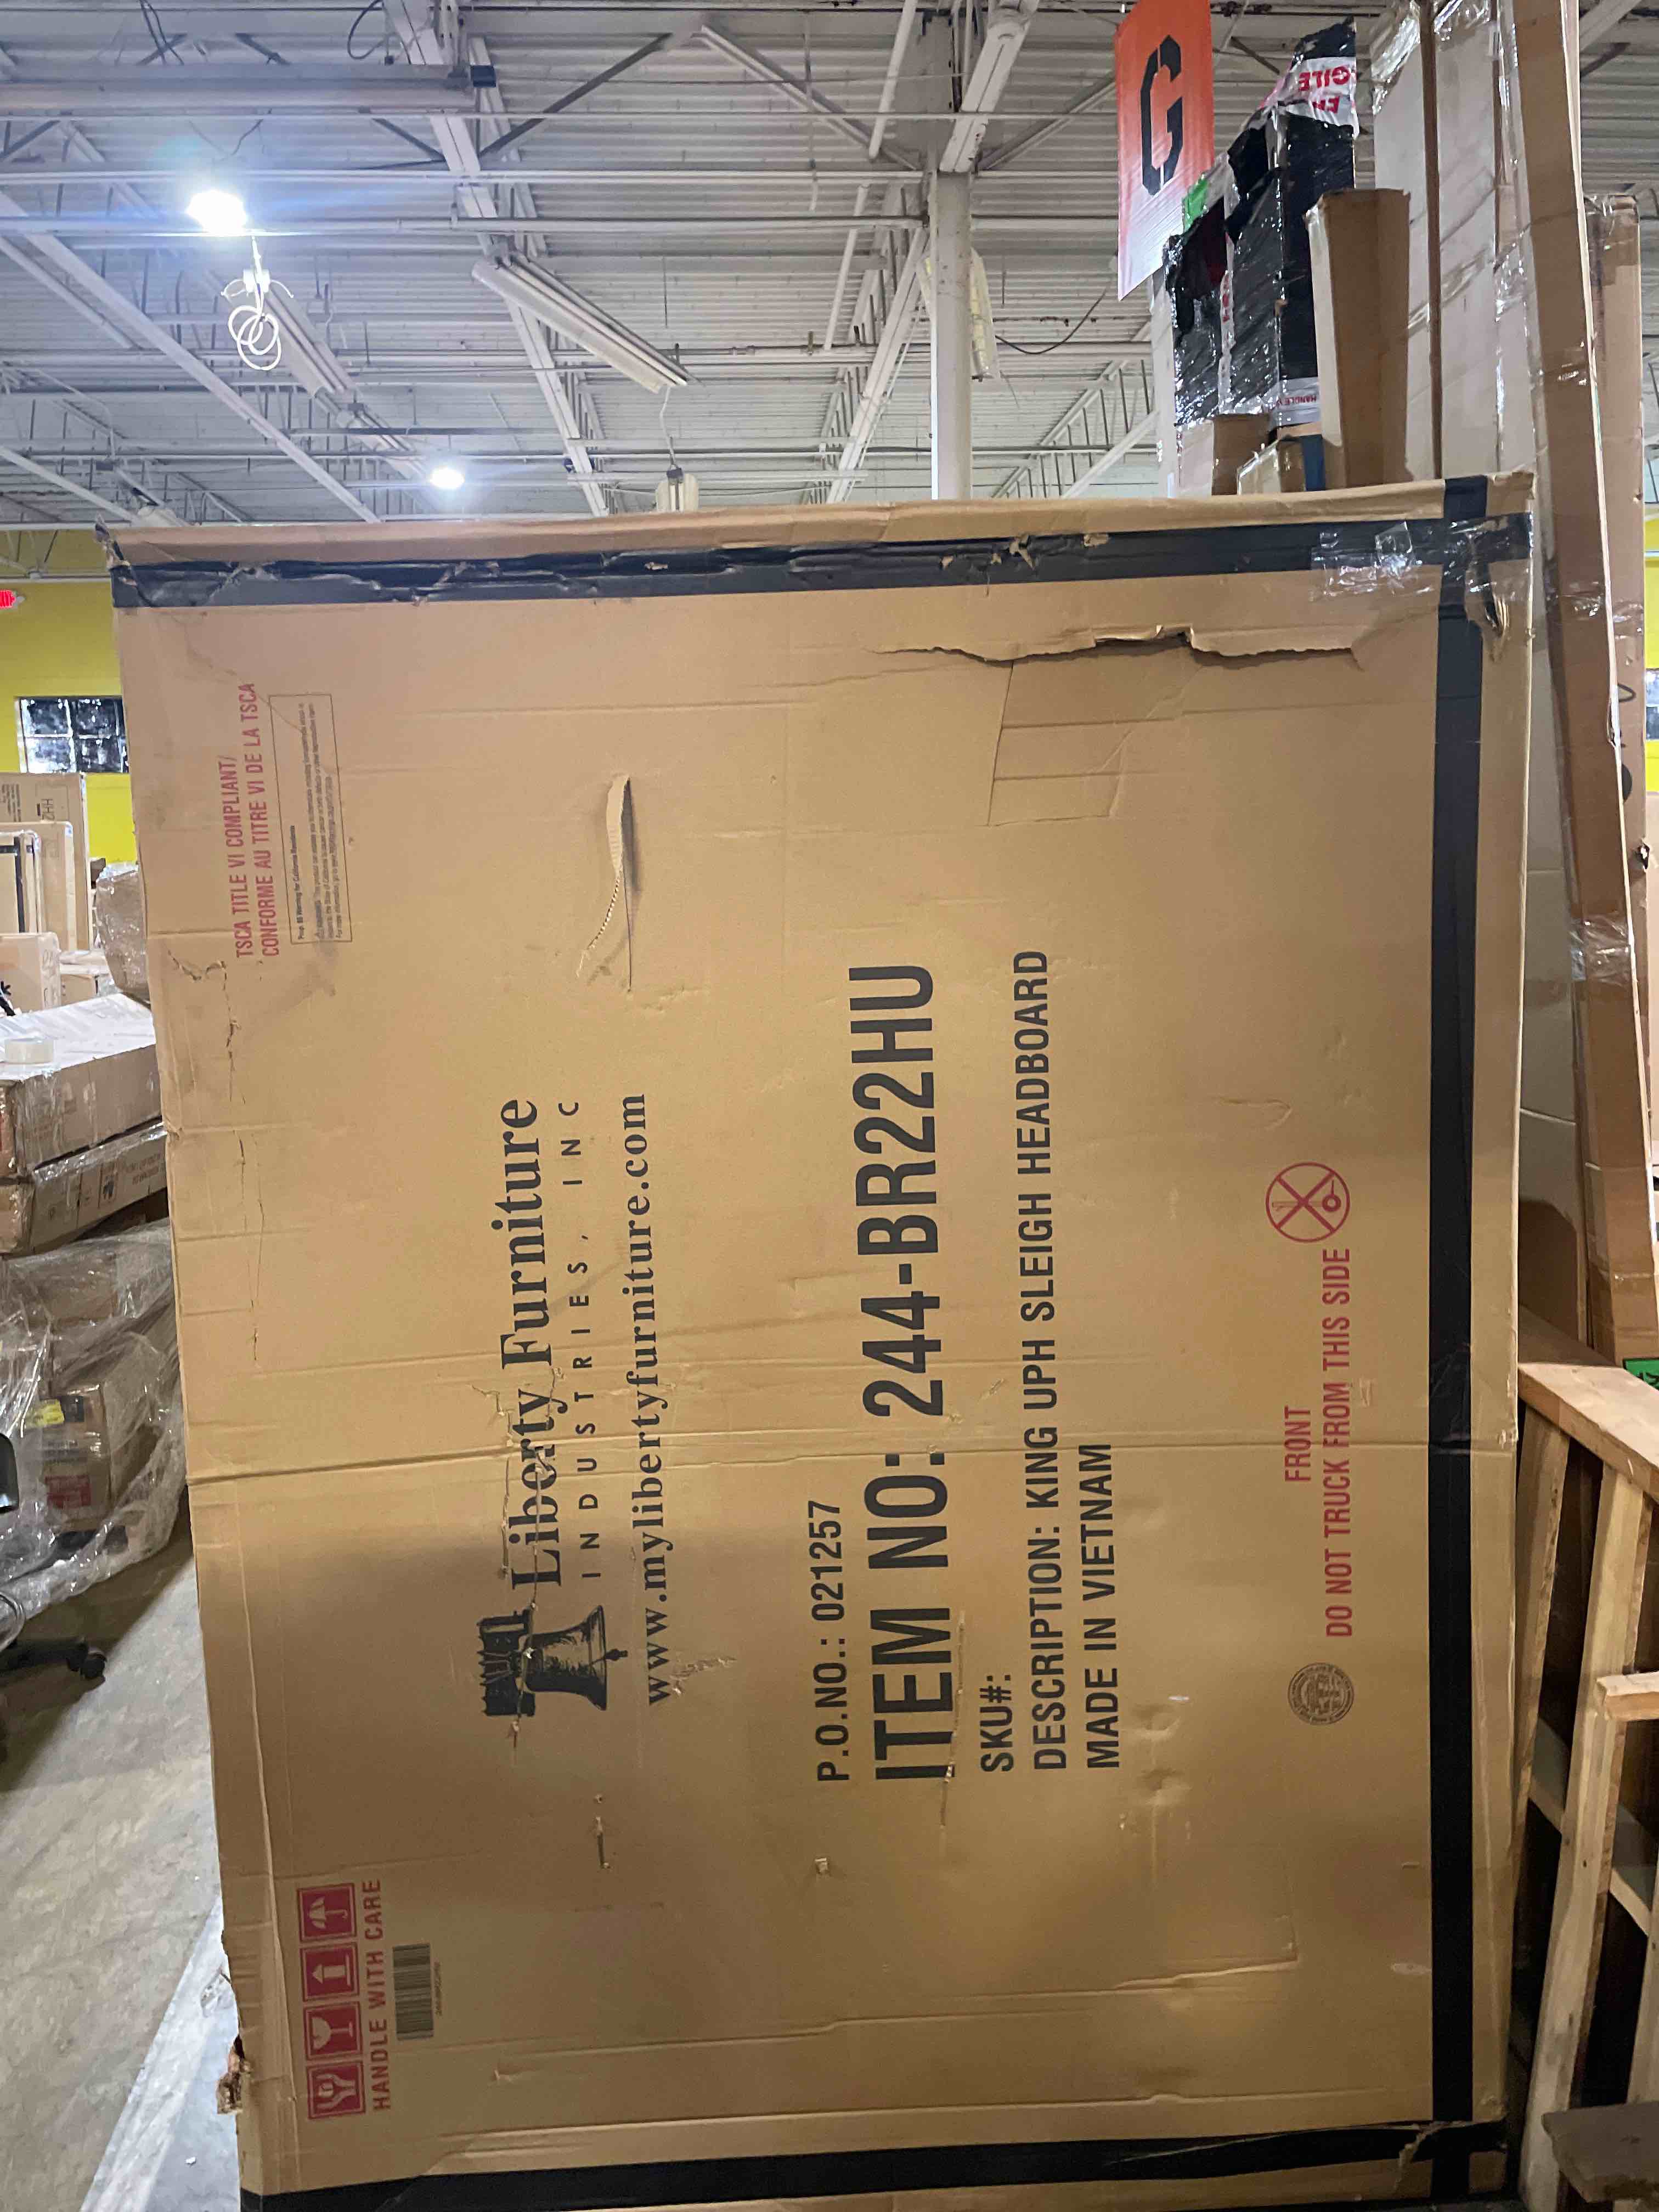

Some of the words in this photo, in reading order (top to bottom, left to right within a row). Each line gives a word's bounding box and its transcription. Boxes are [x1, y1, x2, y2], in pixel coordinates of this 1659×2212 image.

[1140, 35, 1183, 197] G
[238, 683, 259, 724] TSCA
[243, 727, 261, 747] LA
[218, 755, 245, 847] COMPLIANT/
[245, 753, 263, 775] DE
[248, 780, 265, 795] VI
[228, 854, 246, 869] VI
[249, 800, 268, 845] TITRE
[253, 849, 272, 870] AU
[229, 874, 250, 915] TITLE
[255, 874, 279, 957] CONFORME
[233, 921, 253, 958] TSCA
[1013, 950, 1052, 1175] HEADBOARD
[558, 1102, 583, 1185] INC
[848, 965, 944, 1417] 244-BR22HU
[491, 1099, 552, 1370] Furniture
[1018, 1193, 1055, 1322] SLEIGH
[1322, 1248, 1350, 1305] SIDE
[1022, 1339, 1058, 1409] UPH
[1322, 1316, 1350, 1372] THIS
[567, 1235, 601, 1578] INDUSTRIES,
[622, 1094, 674, 1706] www.mylibertyfurniture.com
[1323, 1382, 1351, 1449] FROM
[1023, 1427, 1059, 1509] KING
[1284, 1404, 1311, 1482] FRONT
[509, 1389, 568, 1590] Liberty
[864, 1452, 948, 1570] NO:
[1078, 1444, 1116, 1601] VIETNAM
[1323, 1459, 1351, 1539] TRUCK
[808, 1500, 845, 1622] 021257
[1324, 1548, 1352, 1594] NOT
[1028, 1526, 1067, 1770] DESCRIPTION:
[1084, 1618, 1117, 1651] IN
[1325, 1605, 1352, 1638] DO
[812, 1638, 850, 1781] P.O.NO.:
[870, 1607, 955, 1780] ITEM
[979, 1674, 1014, 1772] SKU#:
[1084, 1668, 1120, 1769] MADE
[362, 1879, 384, 1940] CARE
[366, 1950, 386, 2009] WITH
[369, 2018, 391, 2111] HANDLE
